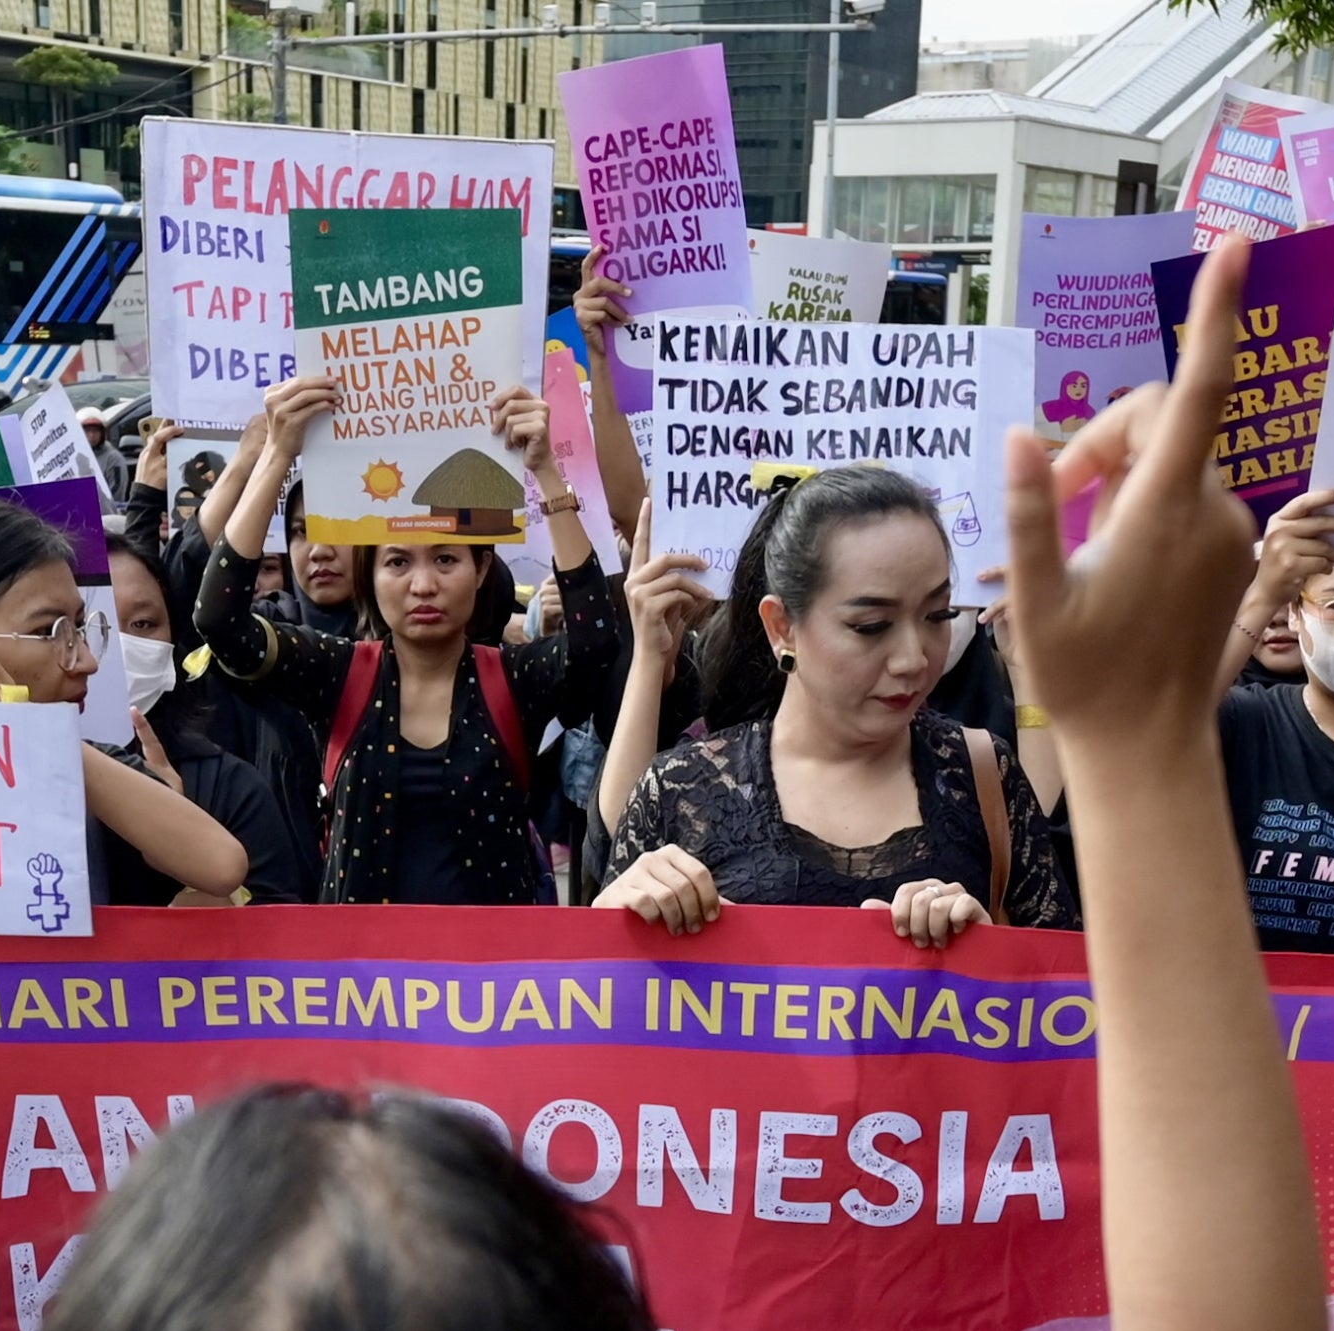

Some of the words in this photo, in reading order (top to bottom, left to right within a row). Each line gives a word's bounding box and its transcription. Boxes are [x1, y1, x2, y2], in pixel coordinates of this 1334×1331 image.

[584, 116, 715, 164] CAPE-CAPE
[1221, 128, 1273, 162] WARIA
[588, 149, 727, 195] REFORMASI,
[1201, 178, 1259, 207] BEBAN
[181, 153, 437, 217] PELANGGAR
[450, 174, 533, 238] HAM
[593, 195, 627, 226] EH
[633, 180, 742, 219] DIKORUPSI
[159, 215, 265, 263] DIBERI
[599, 219, 677, 257] SAMA
[683, 215, 702, 243] SI
[602, 243, 727, 285] OLIGARKI!
[1056, 272, 1155, 292] WUJUDKAN
[173, 280, 267, 324] TAPI
[313, 265, 485, 316] TAMBANG
[786, 281, 845, 305] RUSAK
[320, 316, 483, 361] MELAHAP
[1036, 331, 1122, 349] PEMBELA
[1043, 309, 1156, 330] PEREMPUAN
[657, 321, 850, 367] KENAIKAN
[871, 330, 975, 368] UPAH
[325, 356, 435, 393] HUTAN
[449, 352, 474, 382] &
[331, 387, 415, 416] RUANG
[423, 379, 498, 408] HIDUP
[658, 376, 771, 415] TIDAK
[779, 376, 978, 416] SEBANDING
[30, 408, 48, 436] STOP
[332, 404, 497, 441] MASYARAKAT
[666, 423, 795, 459] DENGAN
[806, 426, 972, 461] KENAIKAN
[160, 975, 613, 1032] PEREMPUAN
[644, 978, 1098, 1050] INTERNASIO
